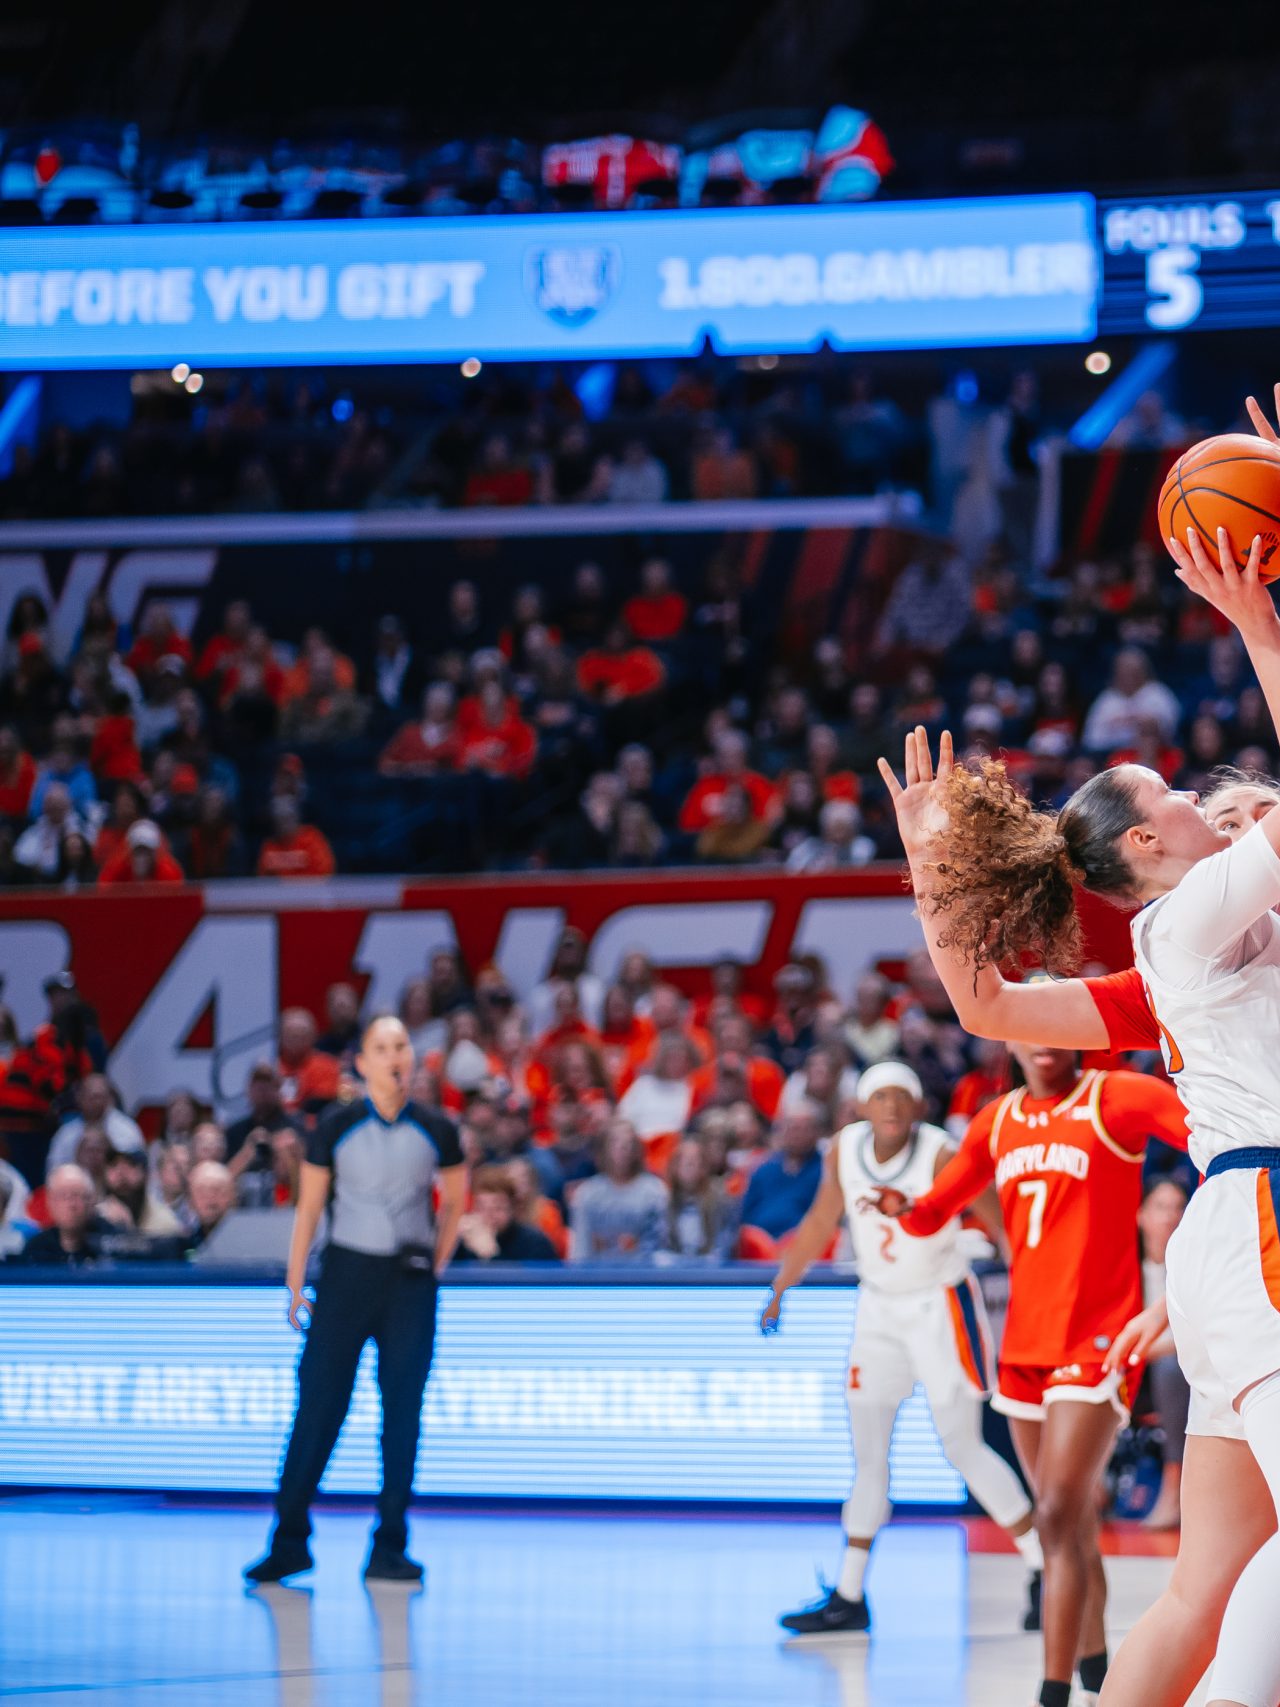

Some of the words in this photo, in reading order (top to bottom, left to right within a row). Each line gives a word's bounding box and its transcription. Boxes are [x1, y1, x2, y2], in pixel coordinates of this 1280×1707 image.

[1105, 202, 1246, 254] FOULS
[0, 268, 195, 327] EFORE
[203, 264, 328, 323] YOU
[337, 258, 486, 320] GIFT
[1146, 246, 1203, 329] 5
[876, 1223, 897, 1265] 2
[1017, 1179, 1047, 1248] 7
[1, 1362, 127, 1424] VISIT
